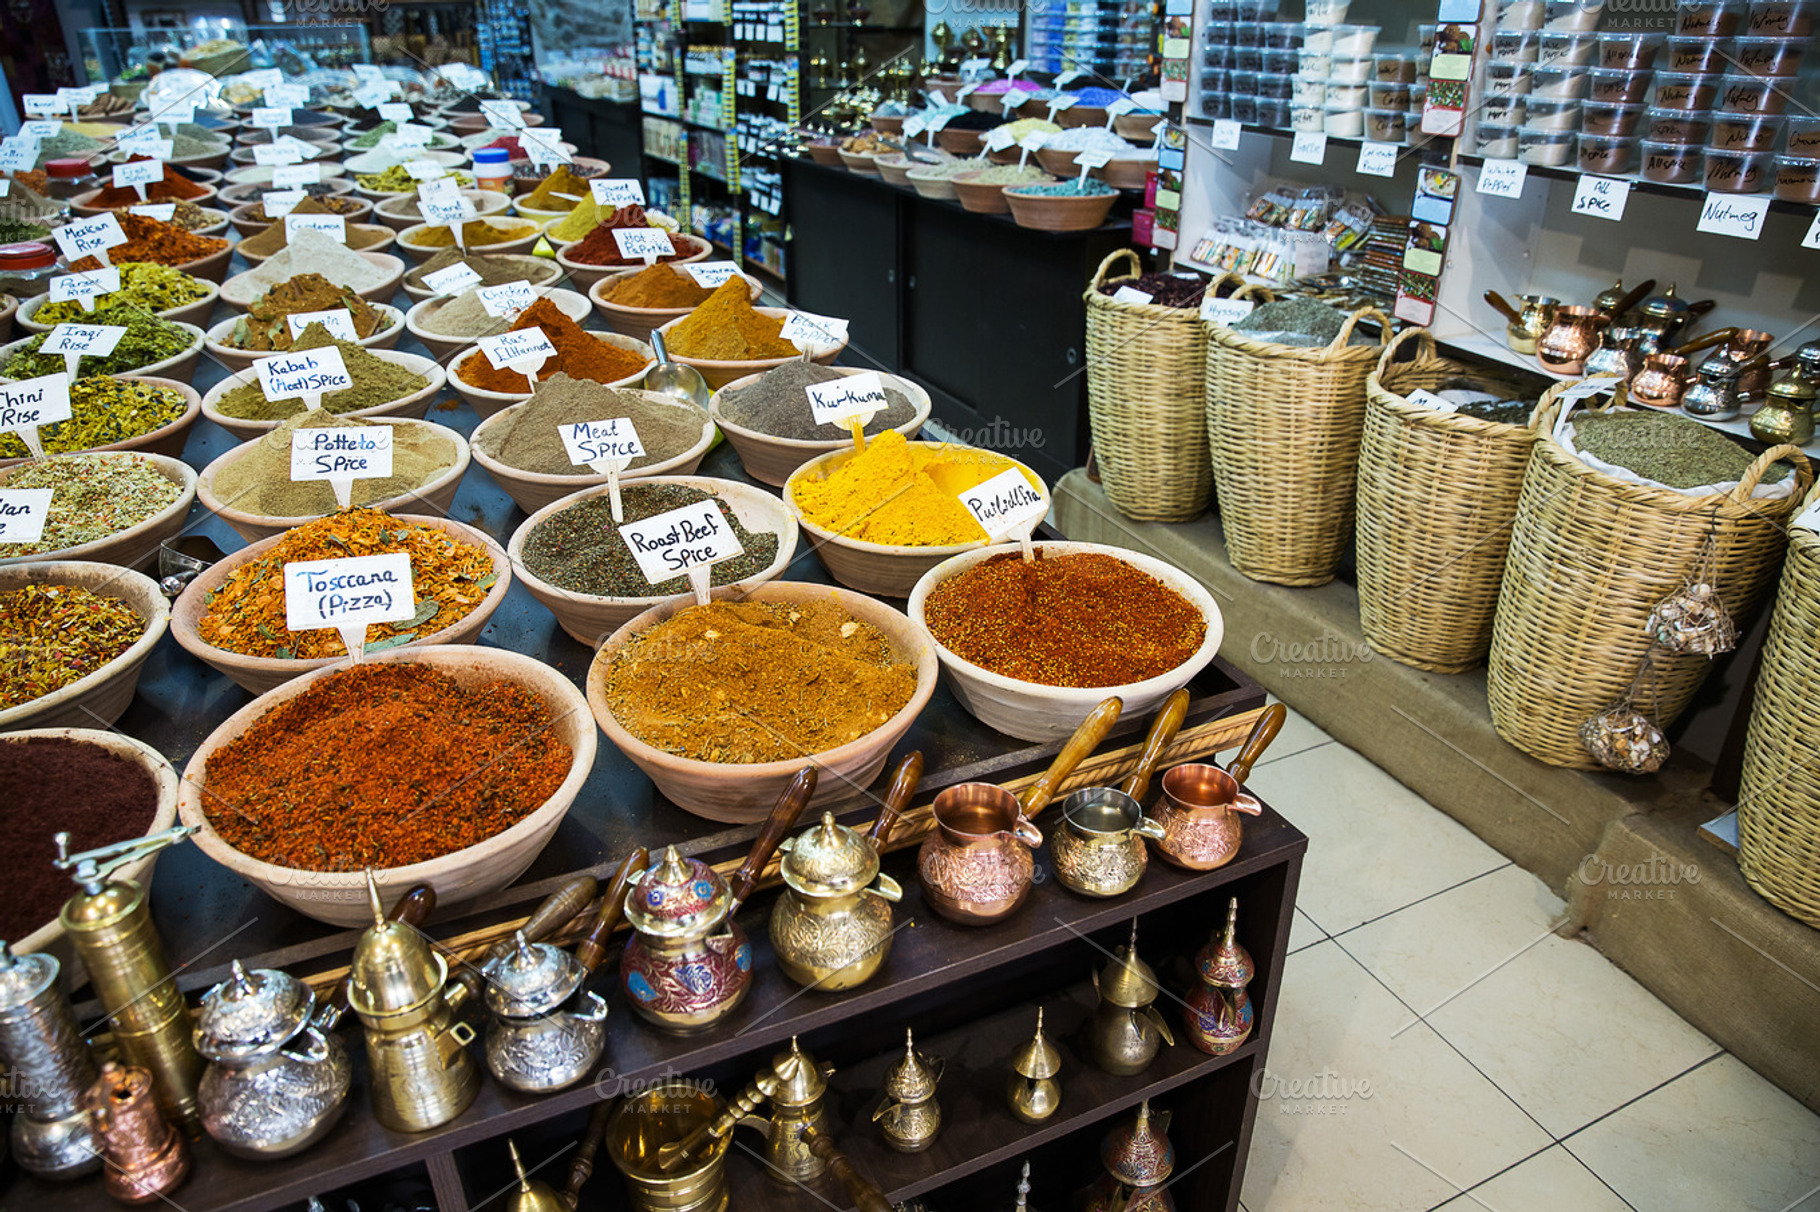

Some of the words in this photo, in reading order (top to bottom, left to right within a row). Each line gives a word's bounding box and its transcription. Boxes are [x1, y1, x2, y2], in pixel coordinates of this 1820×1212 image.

[1703, 200, 1758, 231] Nutmeg
[65, 222, 109, 241] Mexican
[75, 237, 105, 252] Rise
[483, 286, 531, 301] Chicken
[61, 326, 104, 342] Iraqi
[59, 338, 89, 351] Rise
[267, 356, 319, 376] Kabab
[1, 408, 40, 427] Rise
[573, 420, 619, 439] Meat
